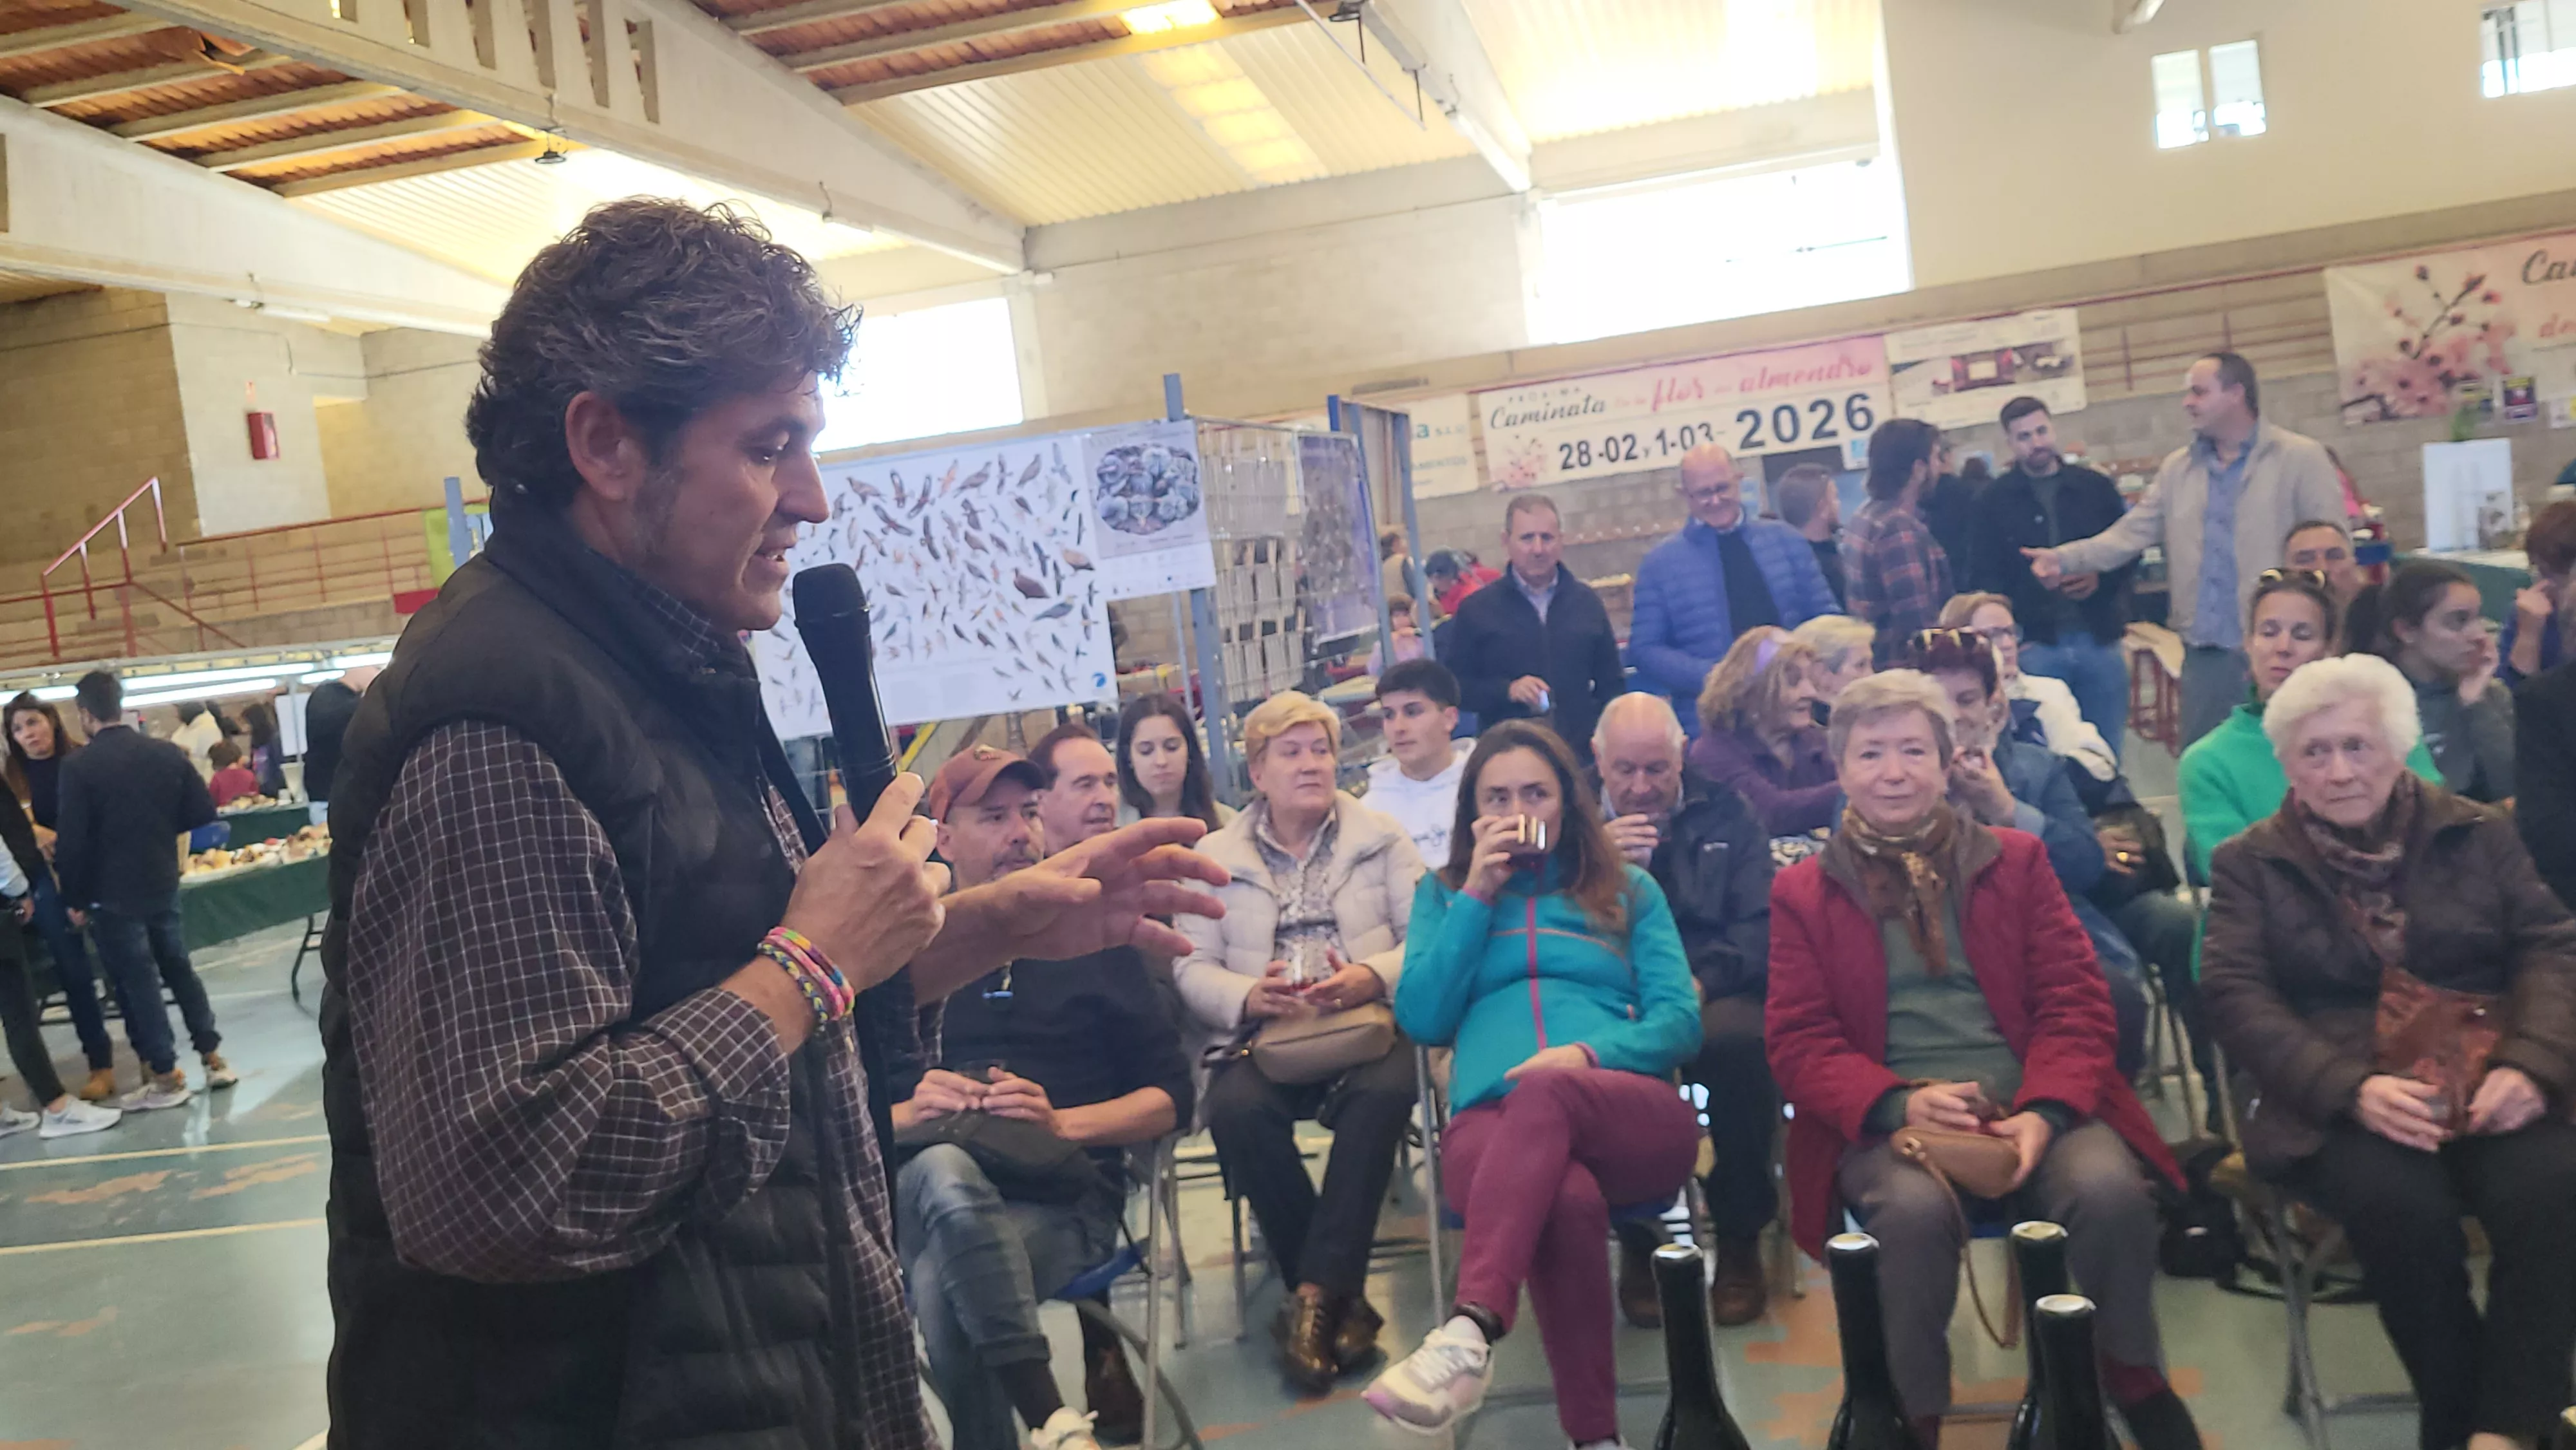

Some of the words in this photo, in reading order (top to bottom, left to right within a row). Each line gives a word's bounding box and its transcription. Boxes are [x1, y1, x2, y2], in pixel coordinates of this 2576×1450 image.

[2523, 249, 2576, 284] Ca
[1490, 394, 1605, 429] Caminata
[1651, 376, 1703, 412] flor
[1739, 354, 1873, 392] almendro
[1736, 392, 1875, 449] 2026
